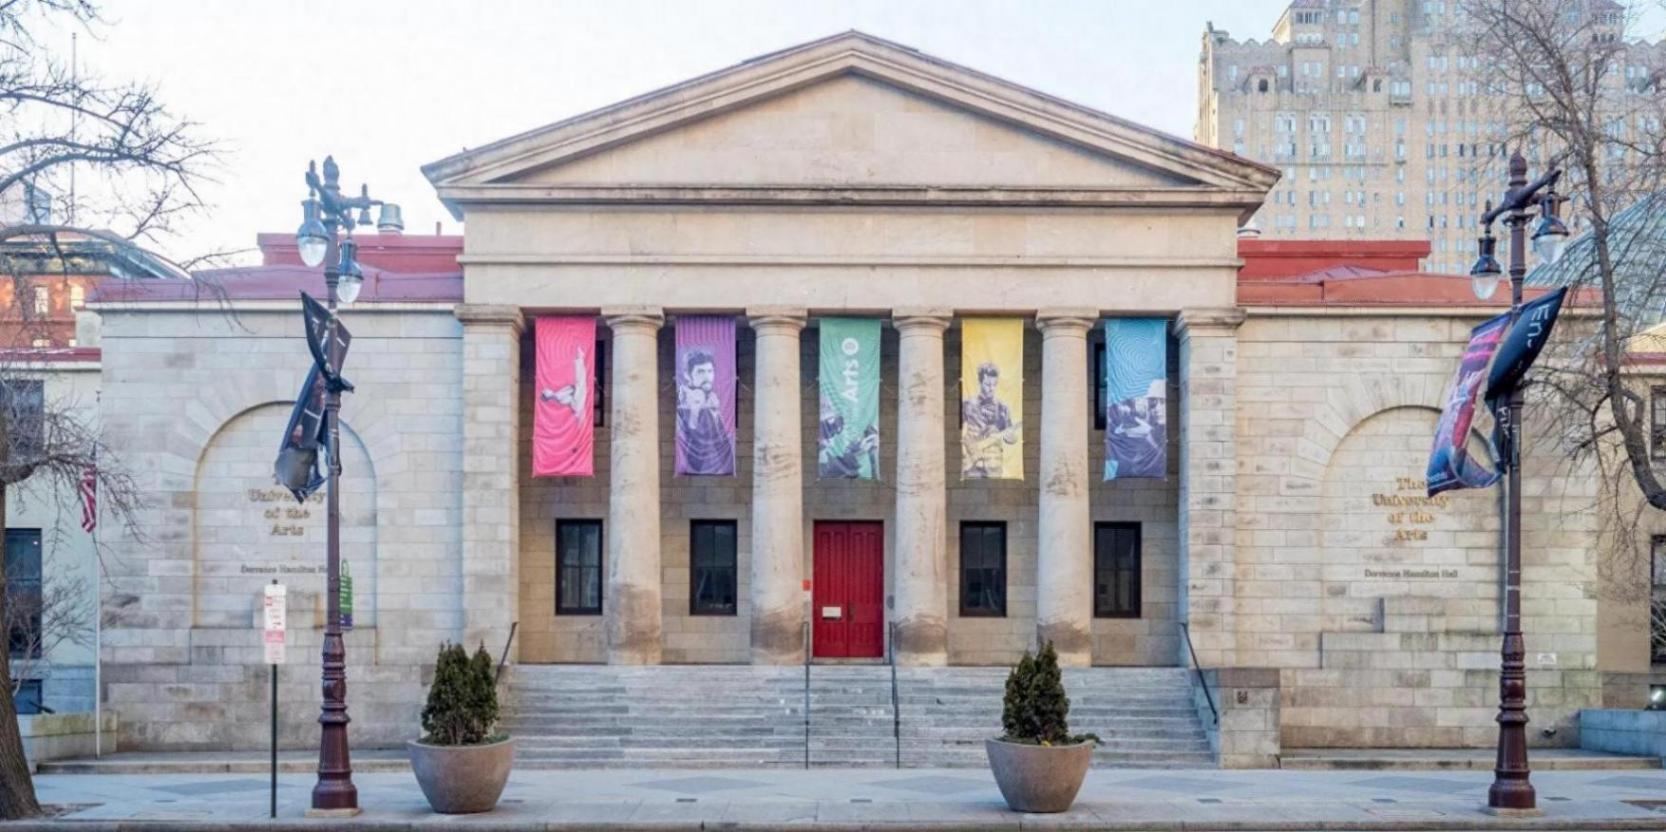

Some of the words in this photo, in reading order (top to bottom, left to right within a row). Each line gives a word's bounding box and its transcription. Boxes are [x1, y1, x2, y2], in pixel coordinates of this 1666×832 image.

[841, 358, 859, 404] Arts
[1395, 477, 1425, 491] The
[1387, 510, 1405, 524] of
[1409, 511, 1434, 524] the
[270, 524, 305, 537] Arts
[1393, 528, 1428, 542] Arts
[1403, 569, 1440, 578] Hamilton
[1441, 569, 1458, 578] Hall
